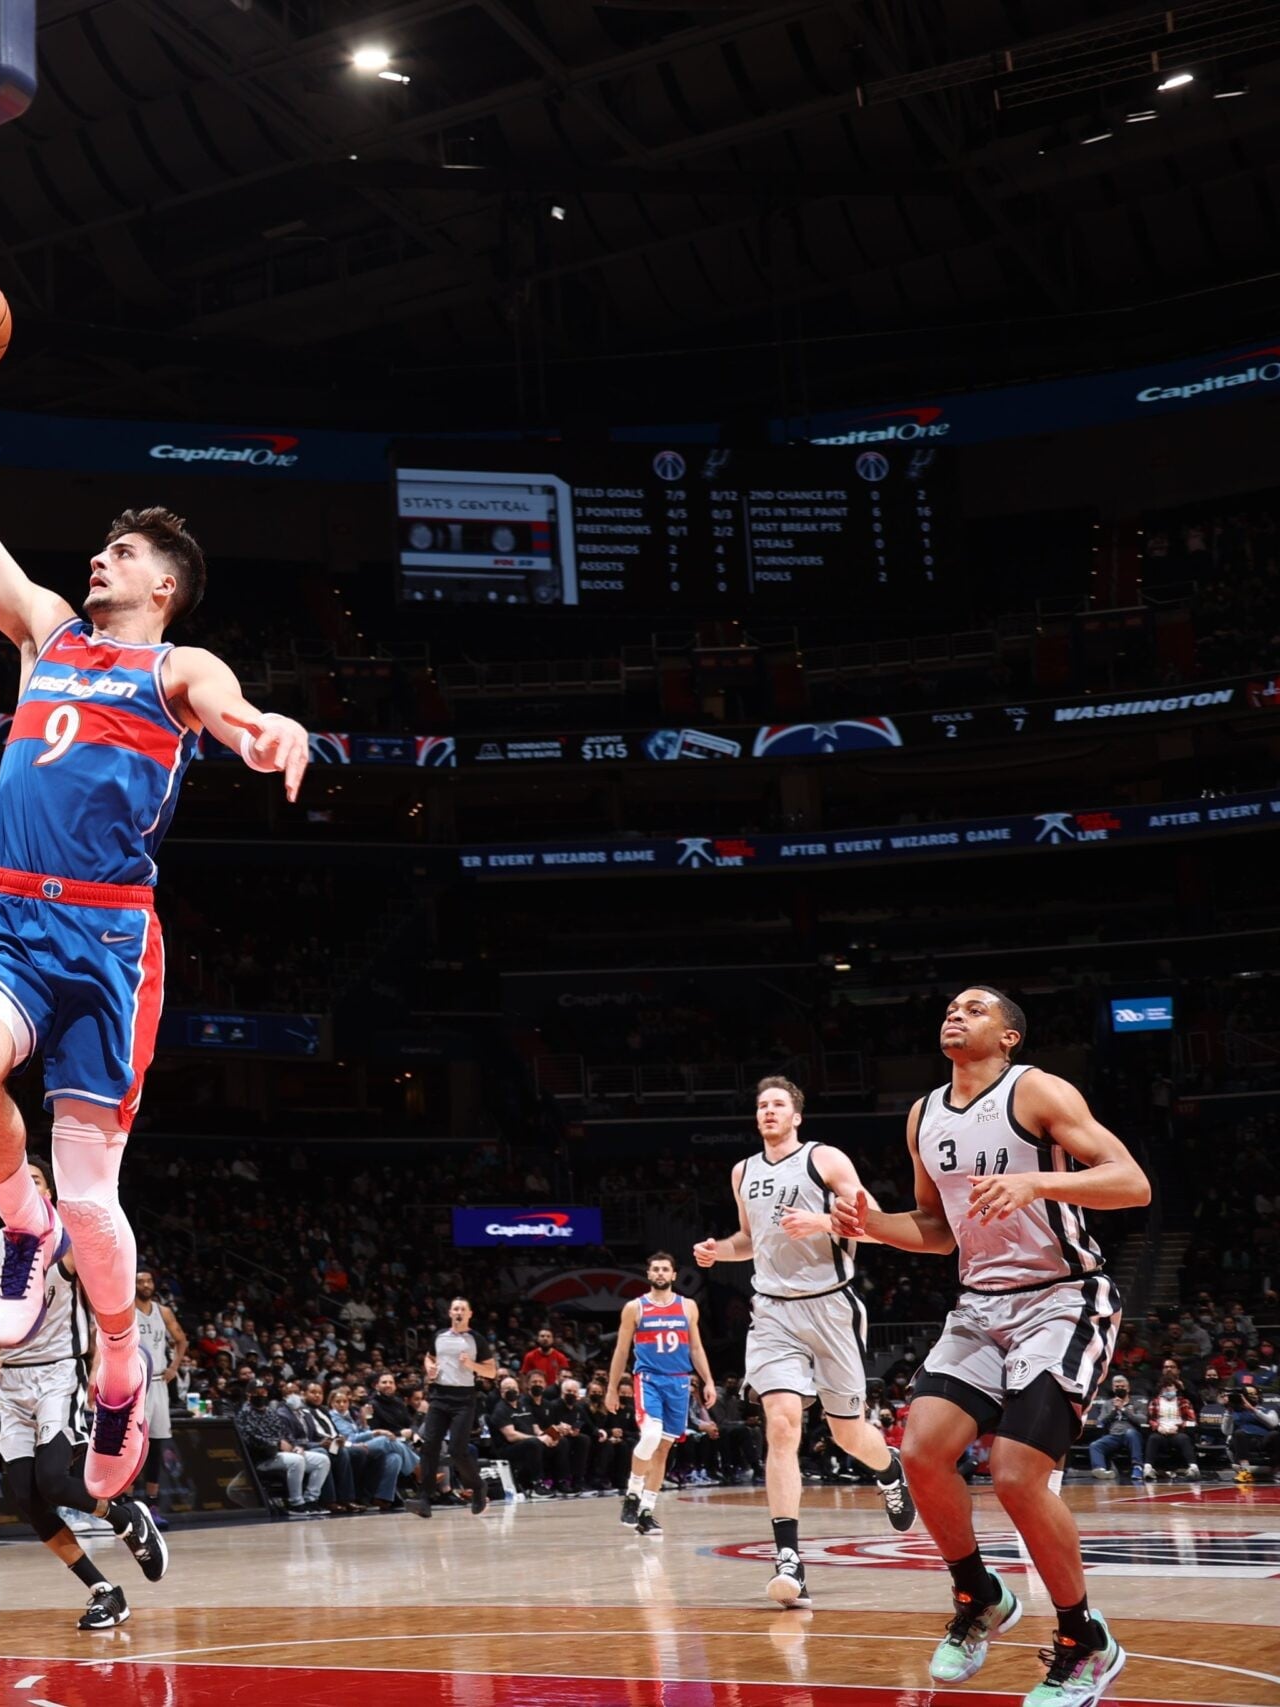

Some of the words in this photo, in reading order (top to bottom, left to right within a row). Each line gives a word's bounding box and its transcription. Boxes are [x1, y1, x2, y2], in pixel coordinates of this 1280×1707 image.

[459, 499, 531, 513] CENTRAL
[585, 507, 644, 519] POINTERS
[1054, 689, 1235, 722] WASHINGTON
[945, 725, 959, 738] 2
[1012, 718, 1025, 731] 7
[32, 703, 81, 767] 9
[581, 743, 628, 761] $145
[1149, 810, 1201, 827] AFTER
[1208, 803, 1263, 821] EVERY
[780, 843, 827, 857] AFTER
[833, 839, 883, 853] EVERY
[890, 832, 959, 849] WIZARDS
[966, 828, 1011, 843] GAME
[1077, 829, 1109, 841] LIVE
[488, 853, 535, 867] EVERY
[542, 851, 607, 865] WIZARDS
[613, 849, 656, 863] GAME
[715, 856, 744, 867] LIVE
[976, 1112, 1000, 1123] Frost
[938, 1139, 958, 1172] 3
[749, 1179, 775, 1200] 25
[139, 1323, 152, 1334] 31
[655, 1331, 680, 1353] 19
